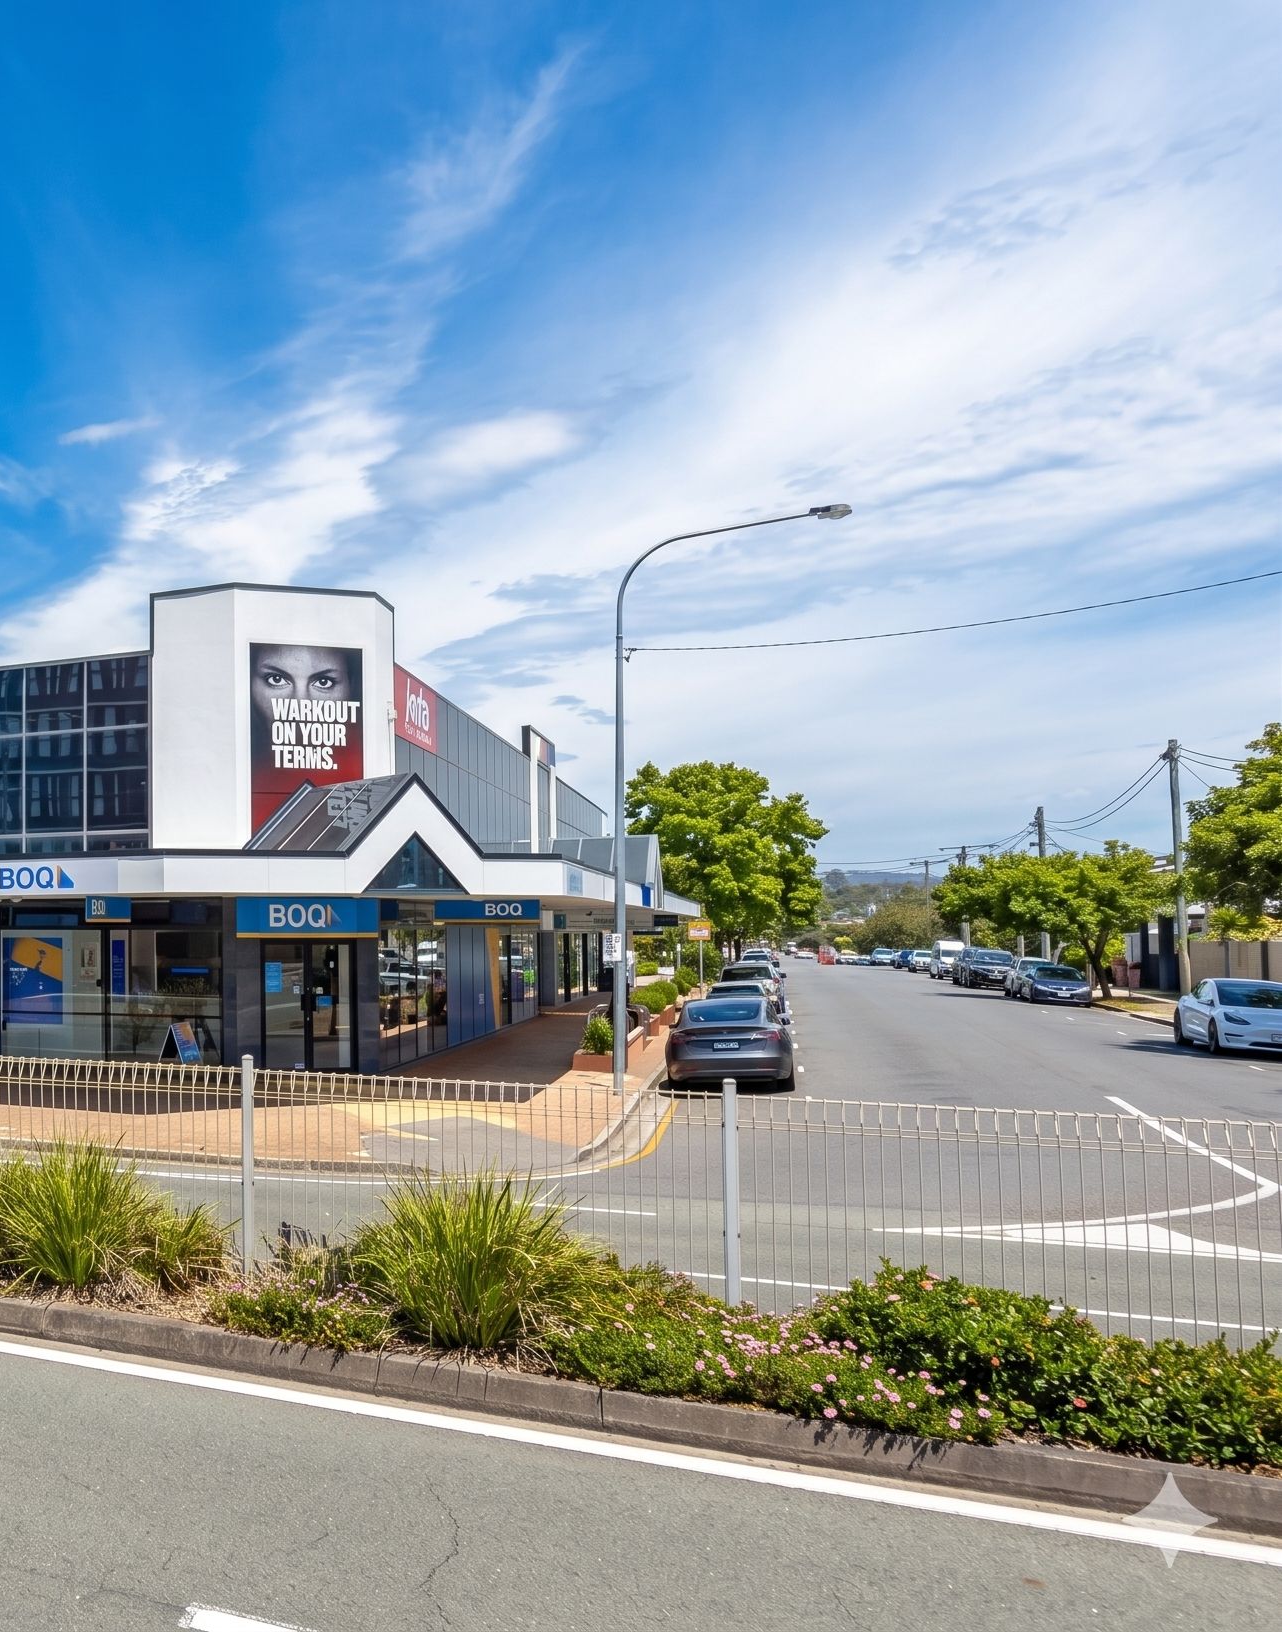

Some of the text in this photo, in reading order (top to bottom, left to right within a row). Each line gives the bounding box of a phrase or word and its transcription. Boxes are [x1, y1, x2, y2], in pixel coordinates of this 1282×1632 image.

[271, 698, 360, 723] WARKOUT
[271, 721, 346, 746] ON YOUR
[271, 745, 338, 770] TERMS.
[0, 866, 54, 889] BOQ
[269, 904, 326, 928] BOQ
[485, 903, 523, 916] BOQ
